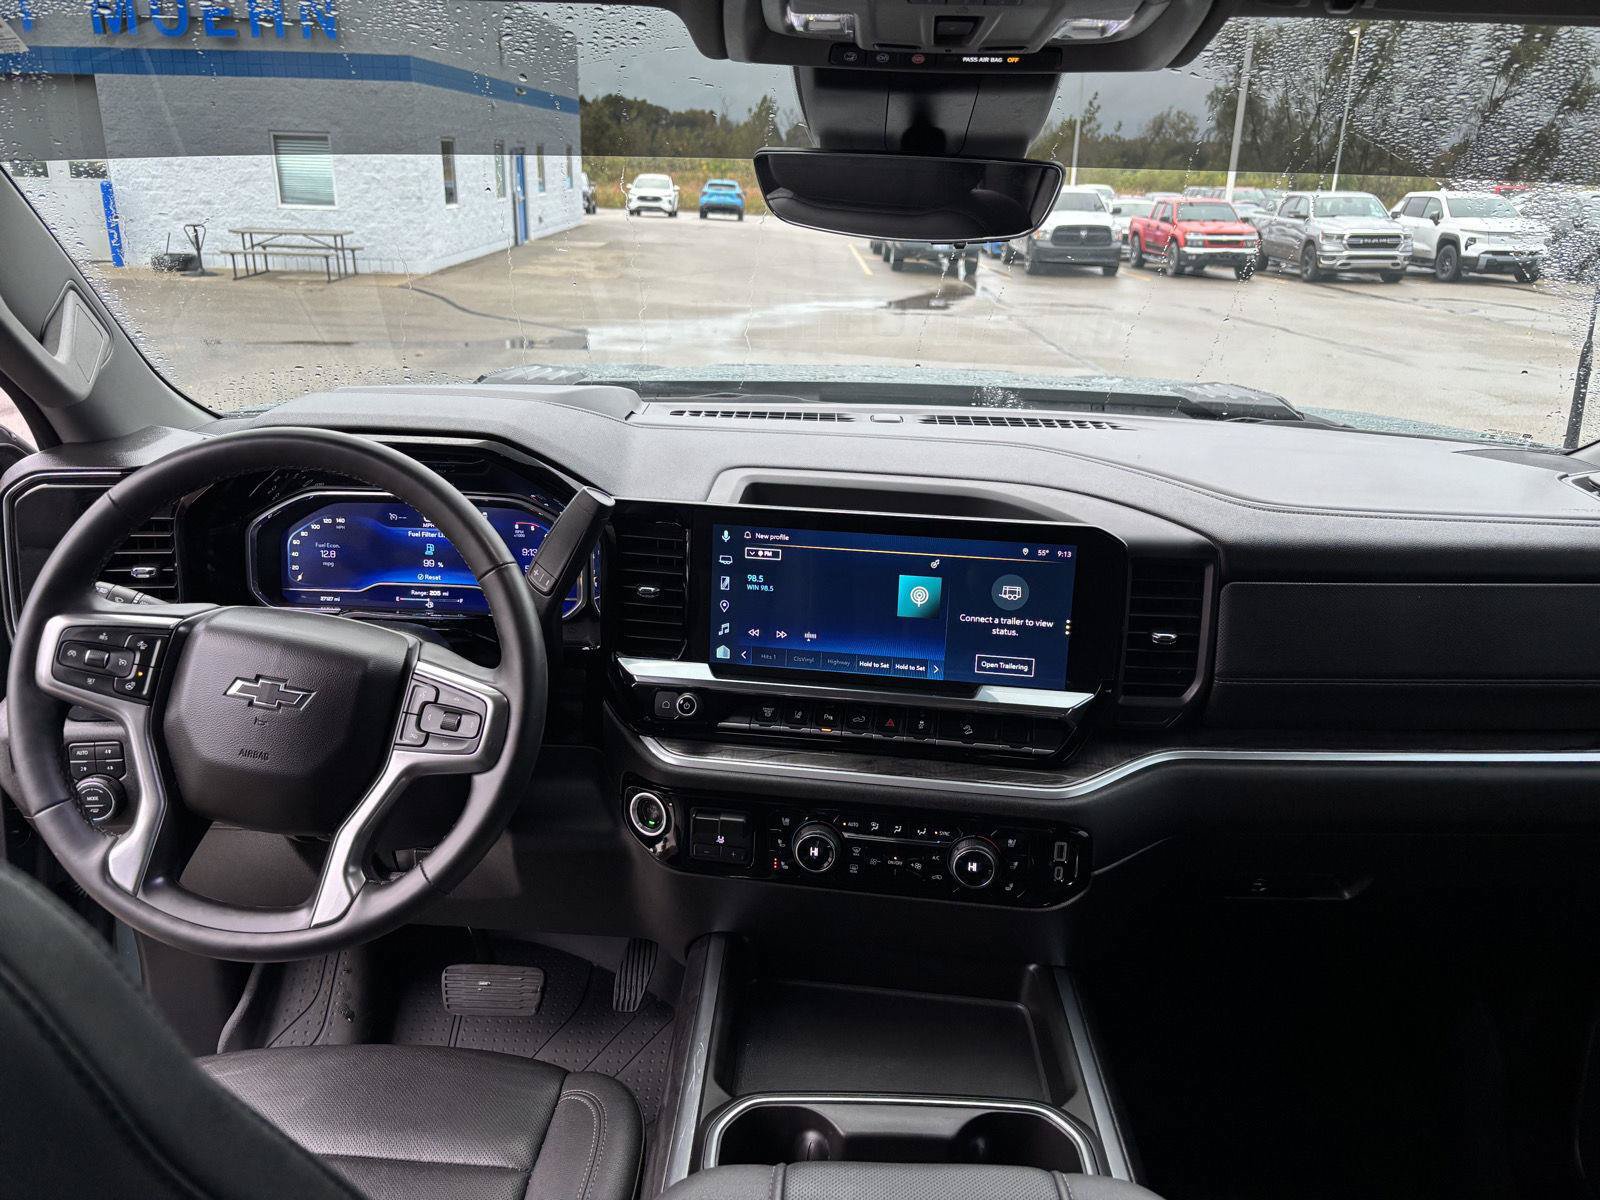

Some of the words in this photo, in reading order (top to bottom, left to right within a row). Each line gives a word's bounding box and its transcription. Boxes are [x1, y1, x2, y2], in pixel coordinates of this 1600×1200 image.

[770, 533, 789, 541] profile
[320, 550, 336, 558] 12.8
[522, 548, 538, 557] 9:13
[1057, 550, 1072, 558] 9:13
[423, 559, 435, 567] 99
[747, 574, 764, 582] 98.5
[960, 613, 993, 624] Connect
[1000, 617, 1024, 626] trailer
[1025, 618, 1034, 626] to
[1035, 619, 1053, 628] view
[991, 627, 1019, 636] status.
[827, 658, 850, 668] Highway
[859, 660, 873, 668] Hold
[981, 660, 998, 669] Open
[999, 661, 1029, 672] Trailering
